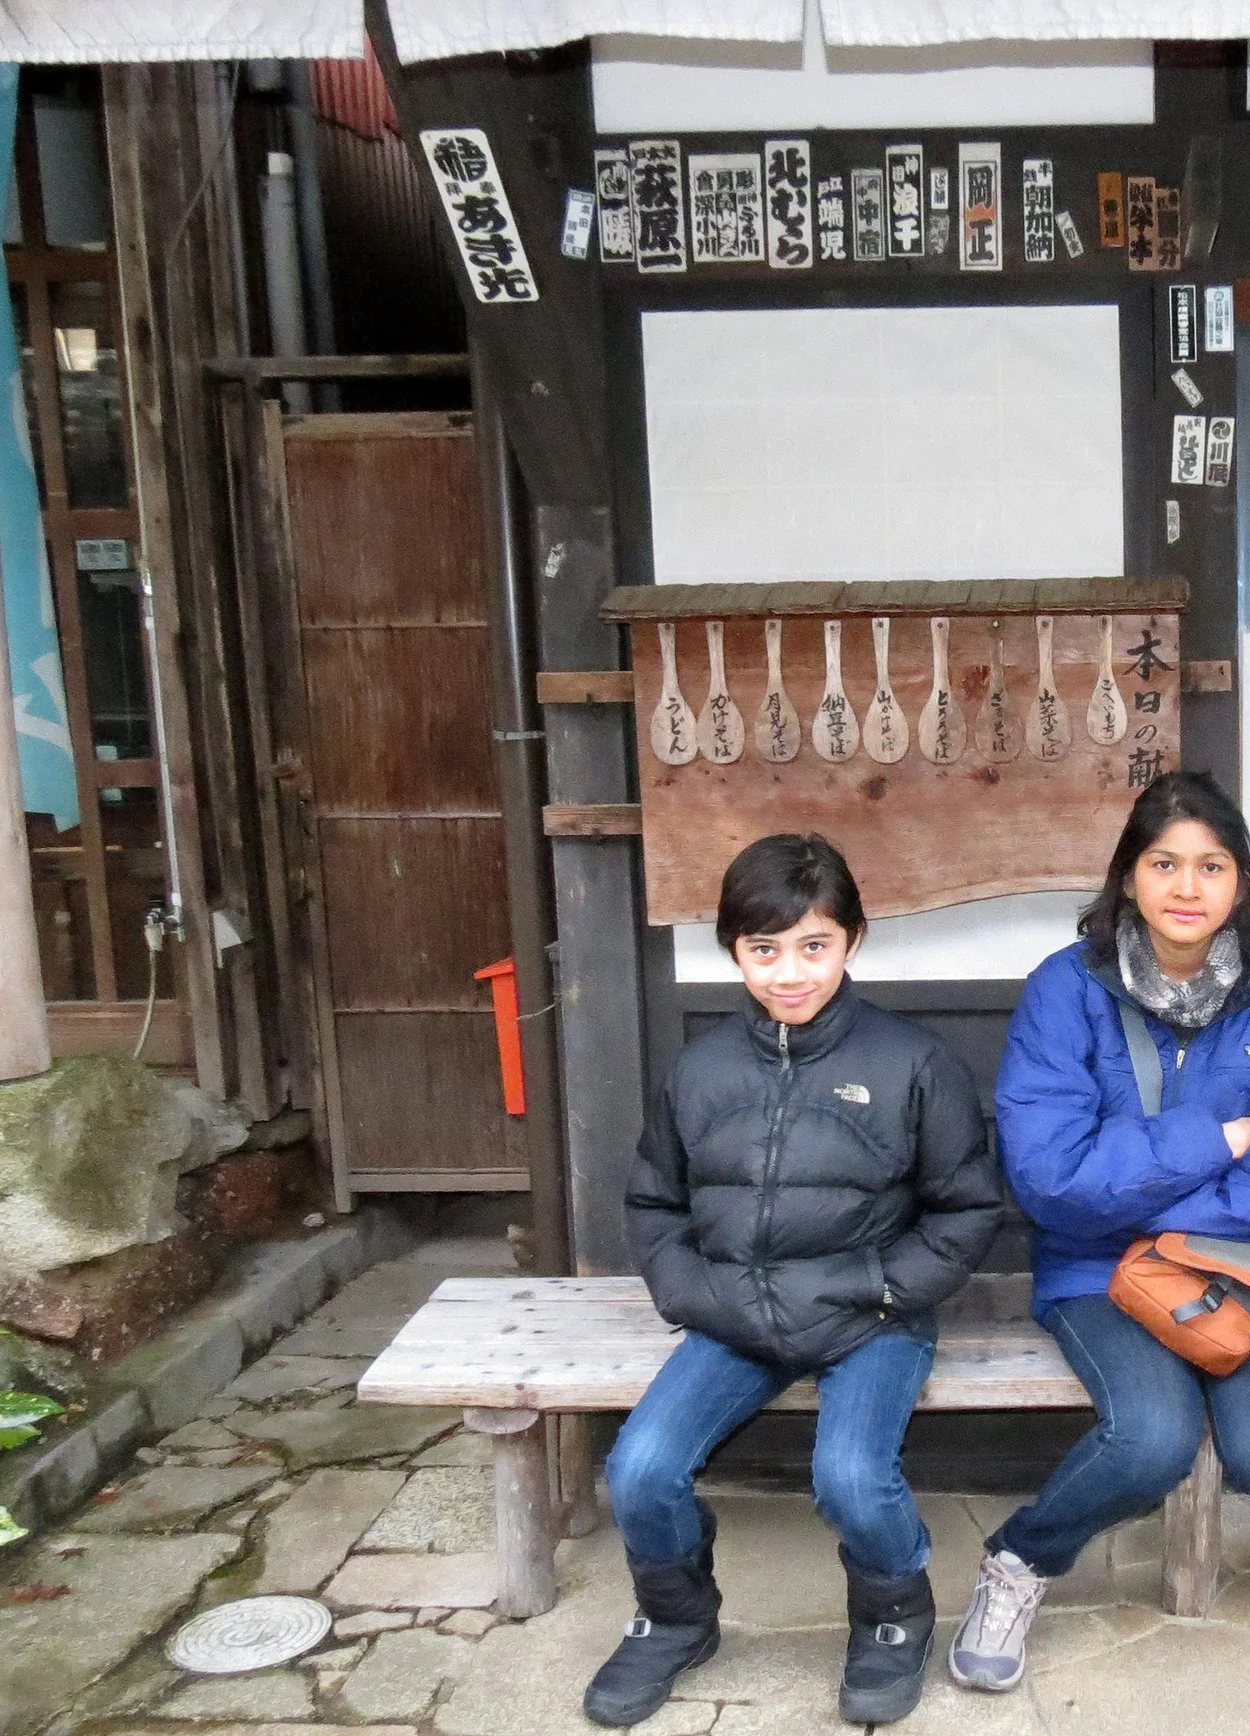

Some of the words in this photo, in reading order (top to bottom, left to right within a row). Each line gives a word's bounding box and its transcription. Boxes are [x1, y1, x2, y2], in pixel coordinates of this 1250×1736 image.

[768, 147, 809, 266] 北むら
[666, 697, 688, 755] うどん
[710, 694, 733, 758] かけそば
[821, 693, 852, 756] 納豆そば
[876, 690, 896, 753] 山かけそば
